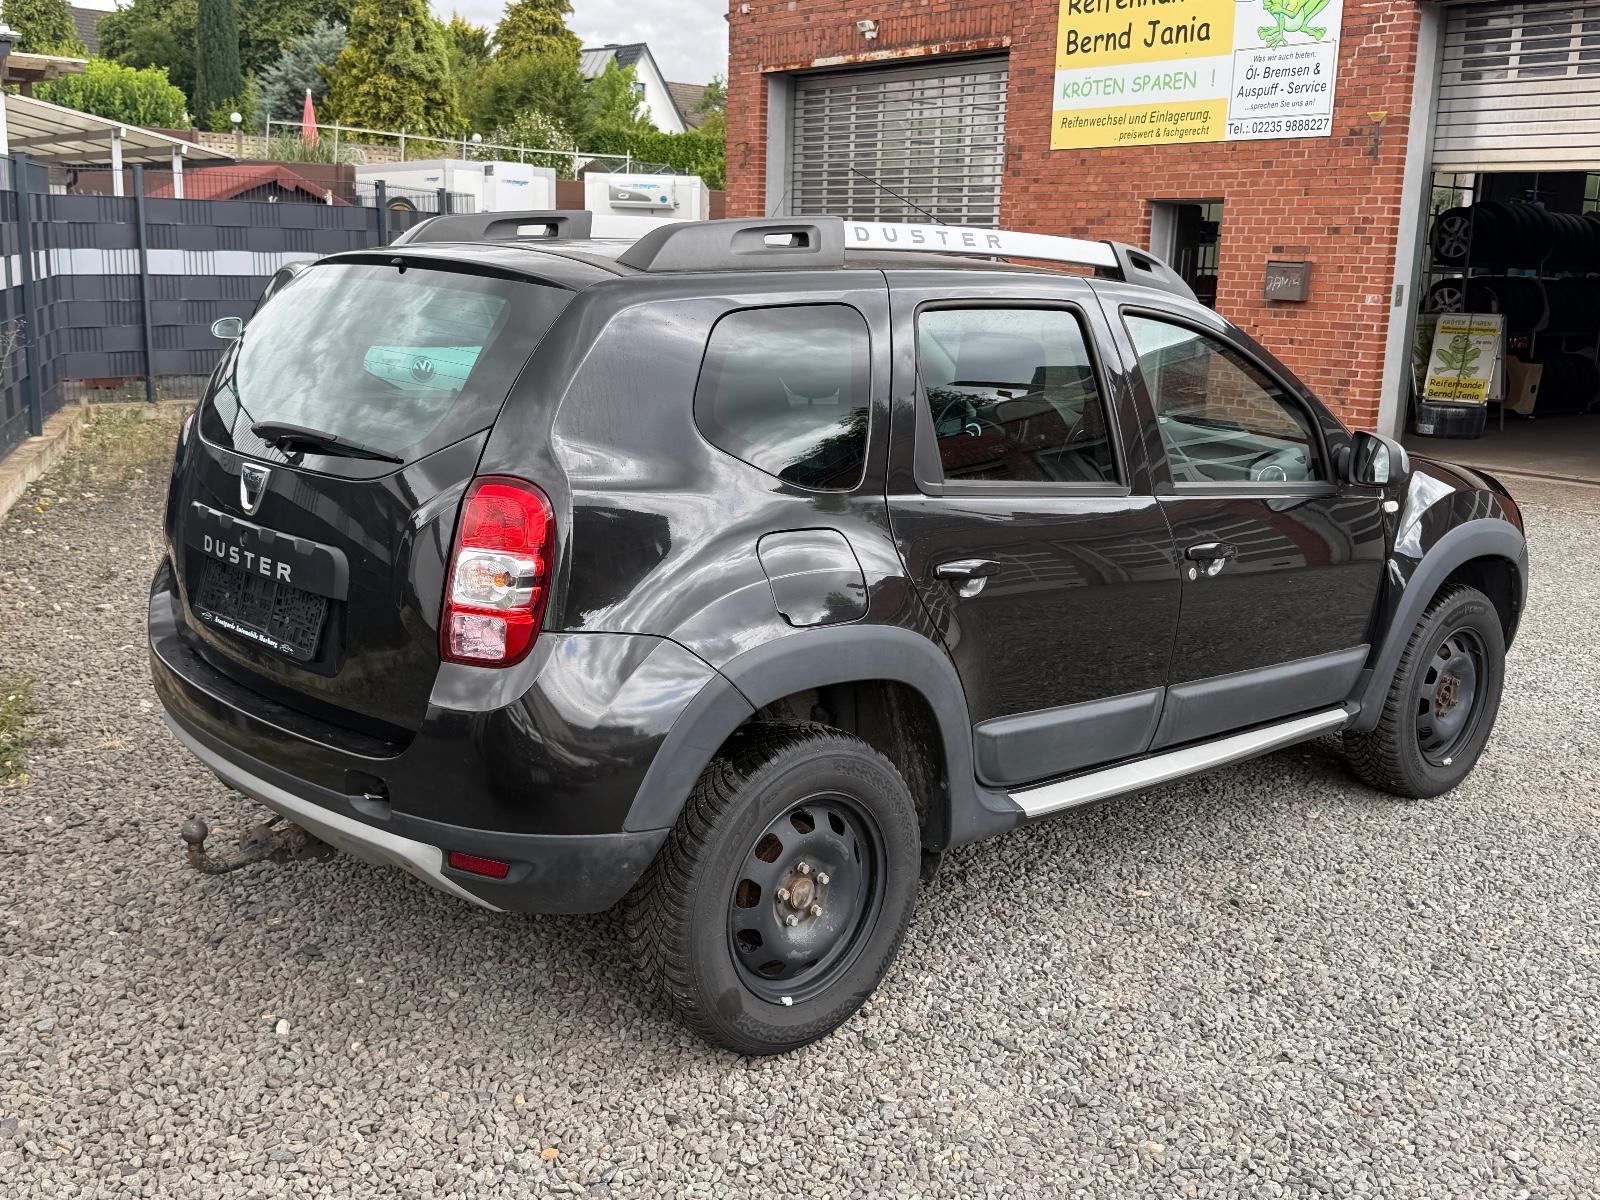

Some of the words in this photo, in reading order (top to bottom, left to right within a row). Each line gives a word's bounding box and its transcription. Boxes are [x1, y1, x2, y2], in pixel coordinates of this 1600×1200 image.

[1066, 22, 1132, 55] Bernd
[1143, 16, 1211, 48] Jania
[1253, 55, 1266, 63] Was
[1267, 53, 1277, 61] wir
[1278, 52, 1293, 60] auch
[1263, 66, 1310, 79] Bremsen
[1313, 62, 1321, 75] &
[1062, 77, 1125, 100] KRÖTEN
[1131, 71, 1197, 93] SPAREN
[1211, 69, 1216, 87] !
[1236, 83, 1279, 100] Auspuff
[1287, 80, 1327, 94] Service
[1060, 113, 1127, 129] Reifenwechsel
[1128, 112, 1148, 125] und
[1150, 109, 1211, 126] Einlagerung.
[1252, 121, 1282, 134] 02235
[1285, 118, 1329, 132] 9888227
[1118, 129, 1154, 142] preiswert
[1155, 128, 1161, 137] &
[1163, 125, 1210, 138] fachgerecht
[854, 226, 1002, 249] DUSTER
[1430, 379, 1485, 389] Reifenhandel
[1428, 389, 1453, 398] Bernd
[1456, 391, 1480, 400] Jania
[203, 534, 293, 583] DUSTER
